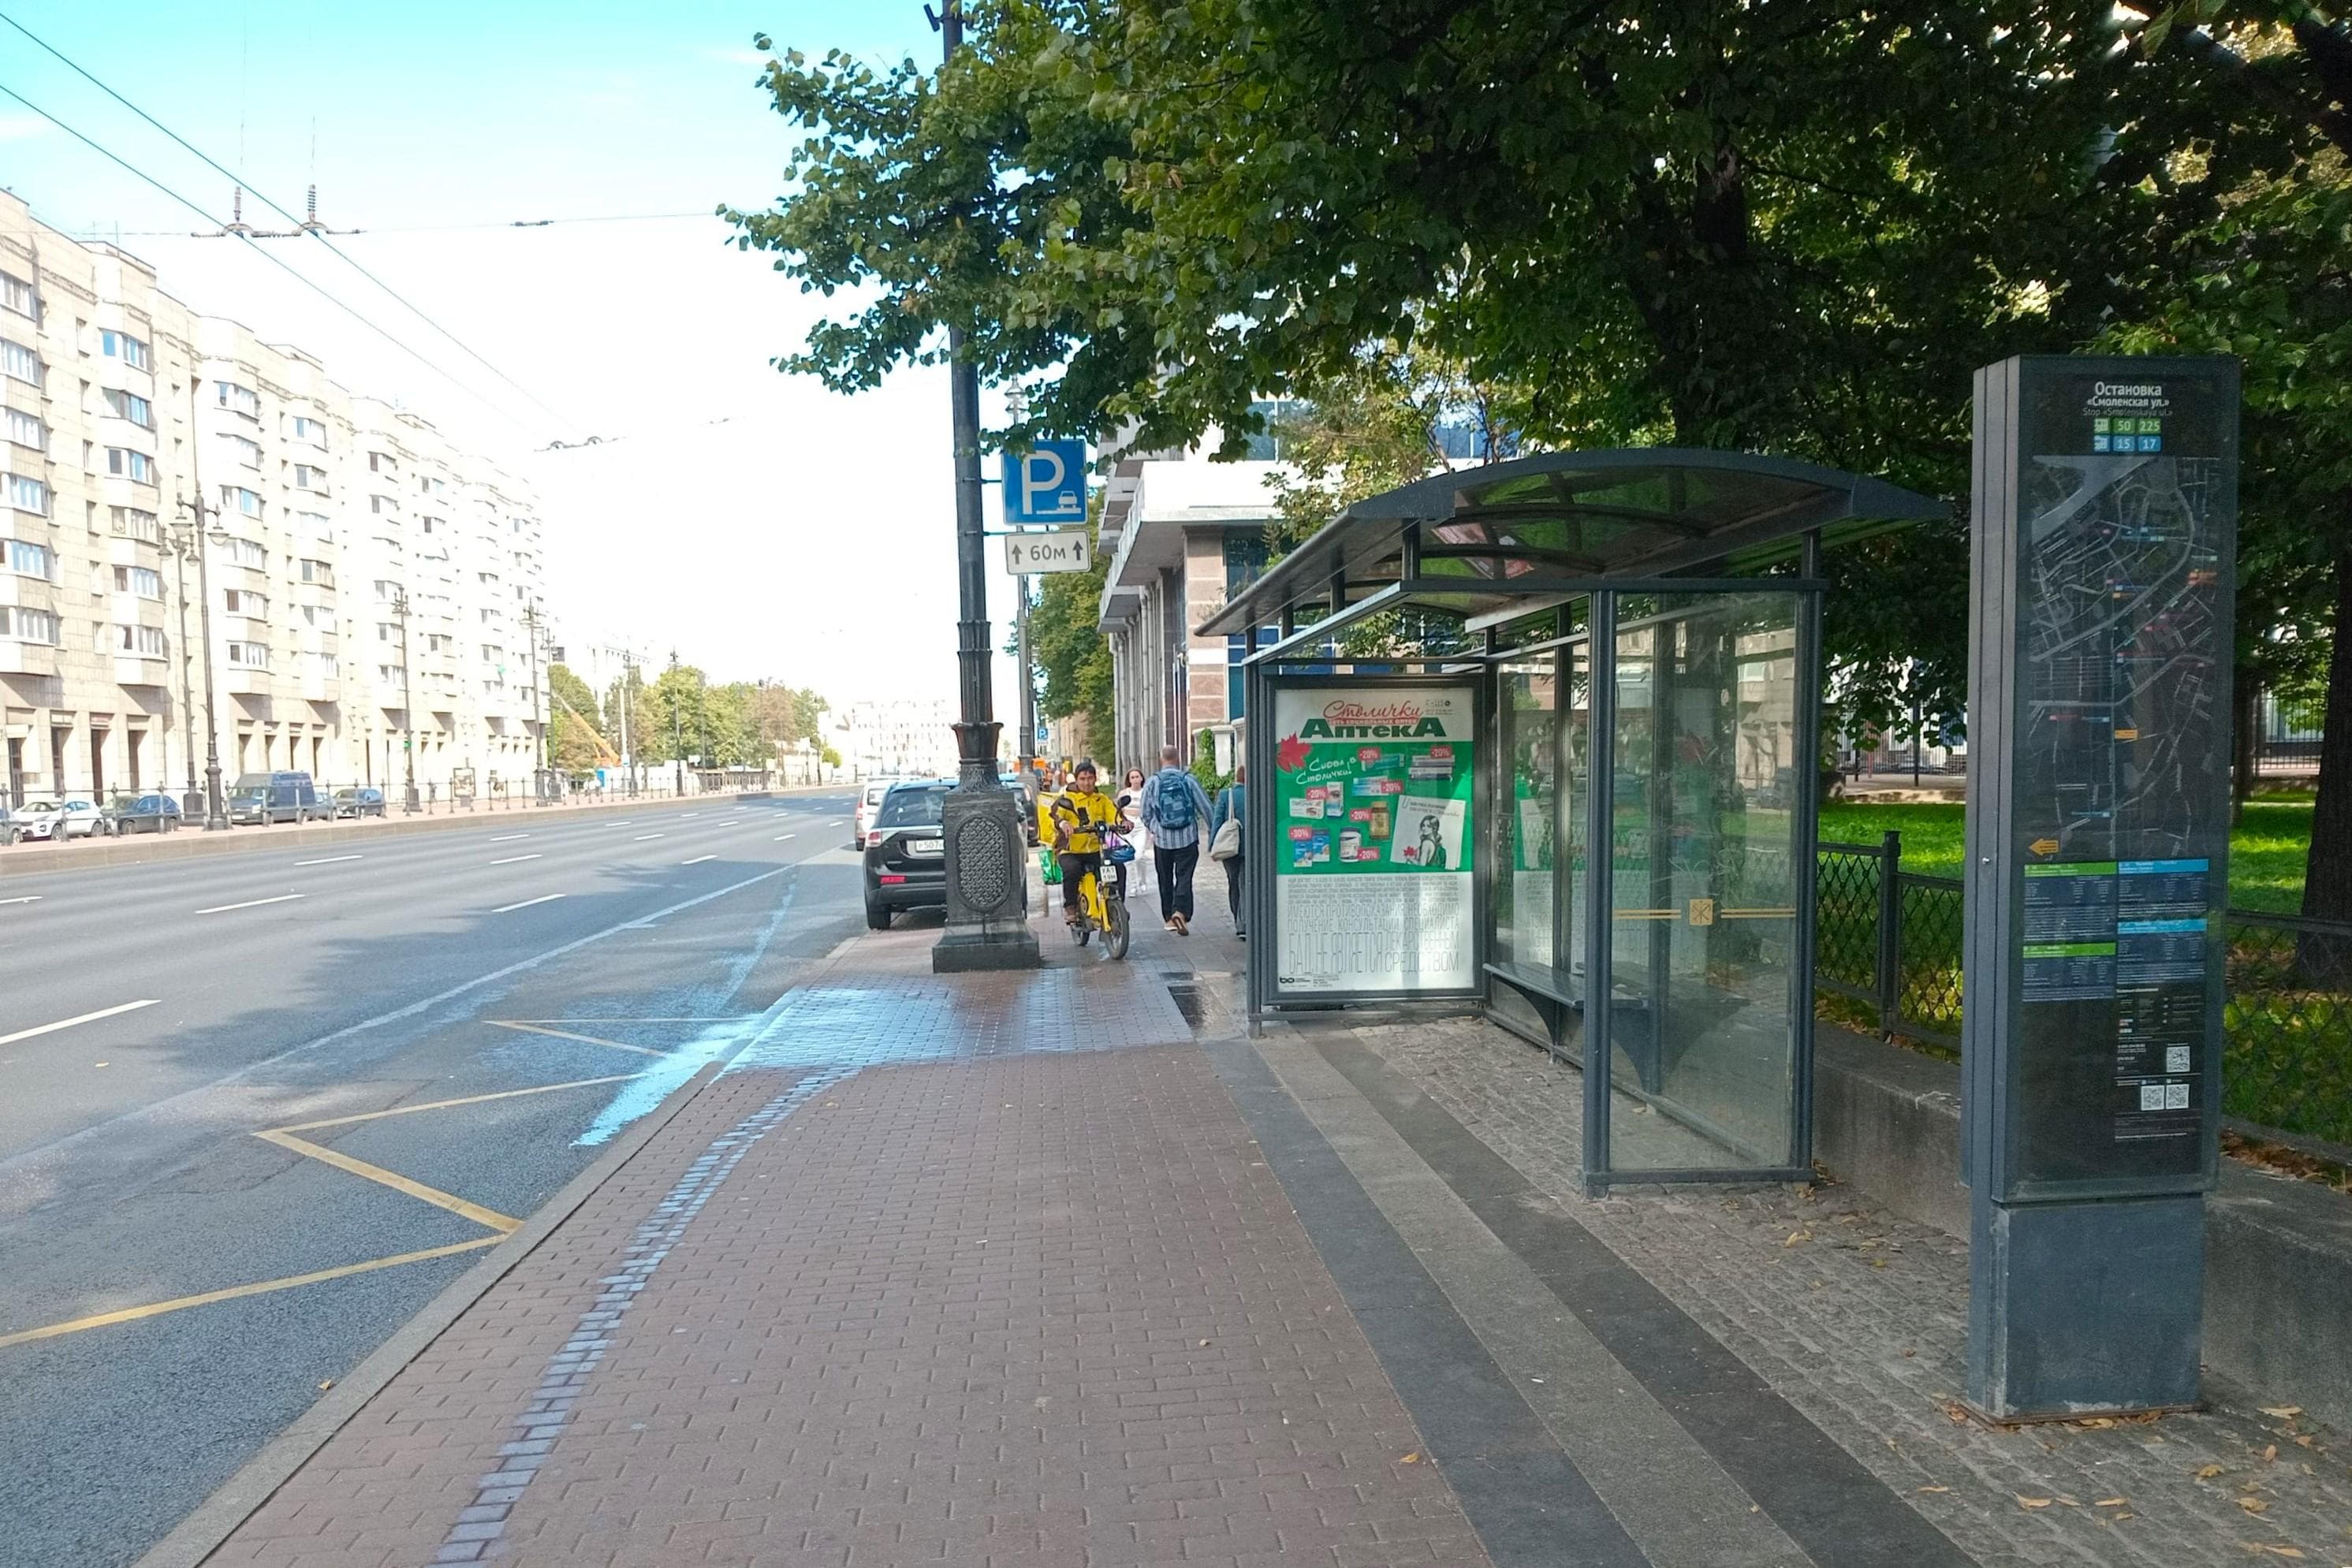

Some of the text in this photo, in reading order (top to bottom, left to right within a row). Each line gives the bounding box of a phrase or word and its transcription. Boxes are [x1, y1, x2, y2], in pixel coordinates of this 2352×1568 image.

[2095, 382, 2162, 396] Остановка
[2087, 396, 2170, 409] «Смоленская ул.»
[2082, 408, 2100, 418] Stop
[2119, 420, 2160, 432] 50 225
[2118, 438, 2156, 449] 15 17
[1021, 450, 1064, 515] P
[1323, 700, 1424, 719] Столички
[1359, 750, 1378, 759] -20%
[1383, 782, 1401, 791] -20%
[1307, 789, 1326, 799] -20%
[1351, 810, 1370, 820] -20%
[1291, 829, 1309, 838] -30%
[1359, 850, 1377, 859] -20%
[1385, 952, 1459, 974] СРЕДСТВОМ
